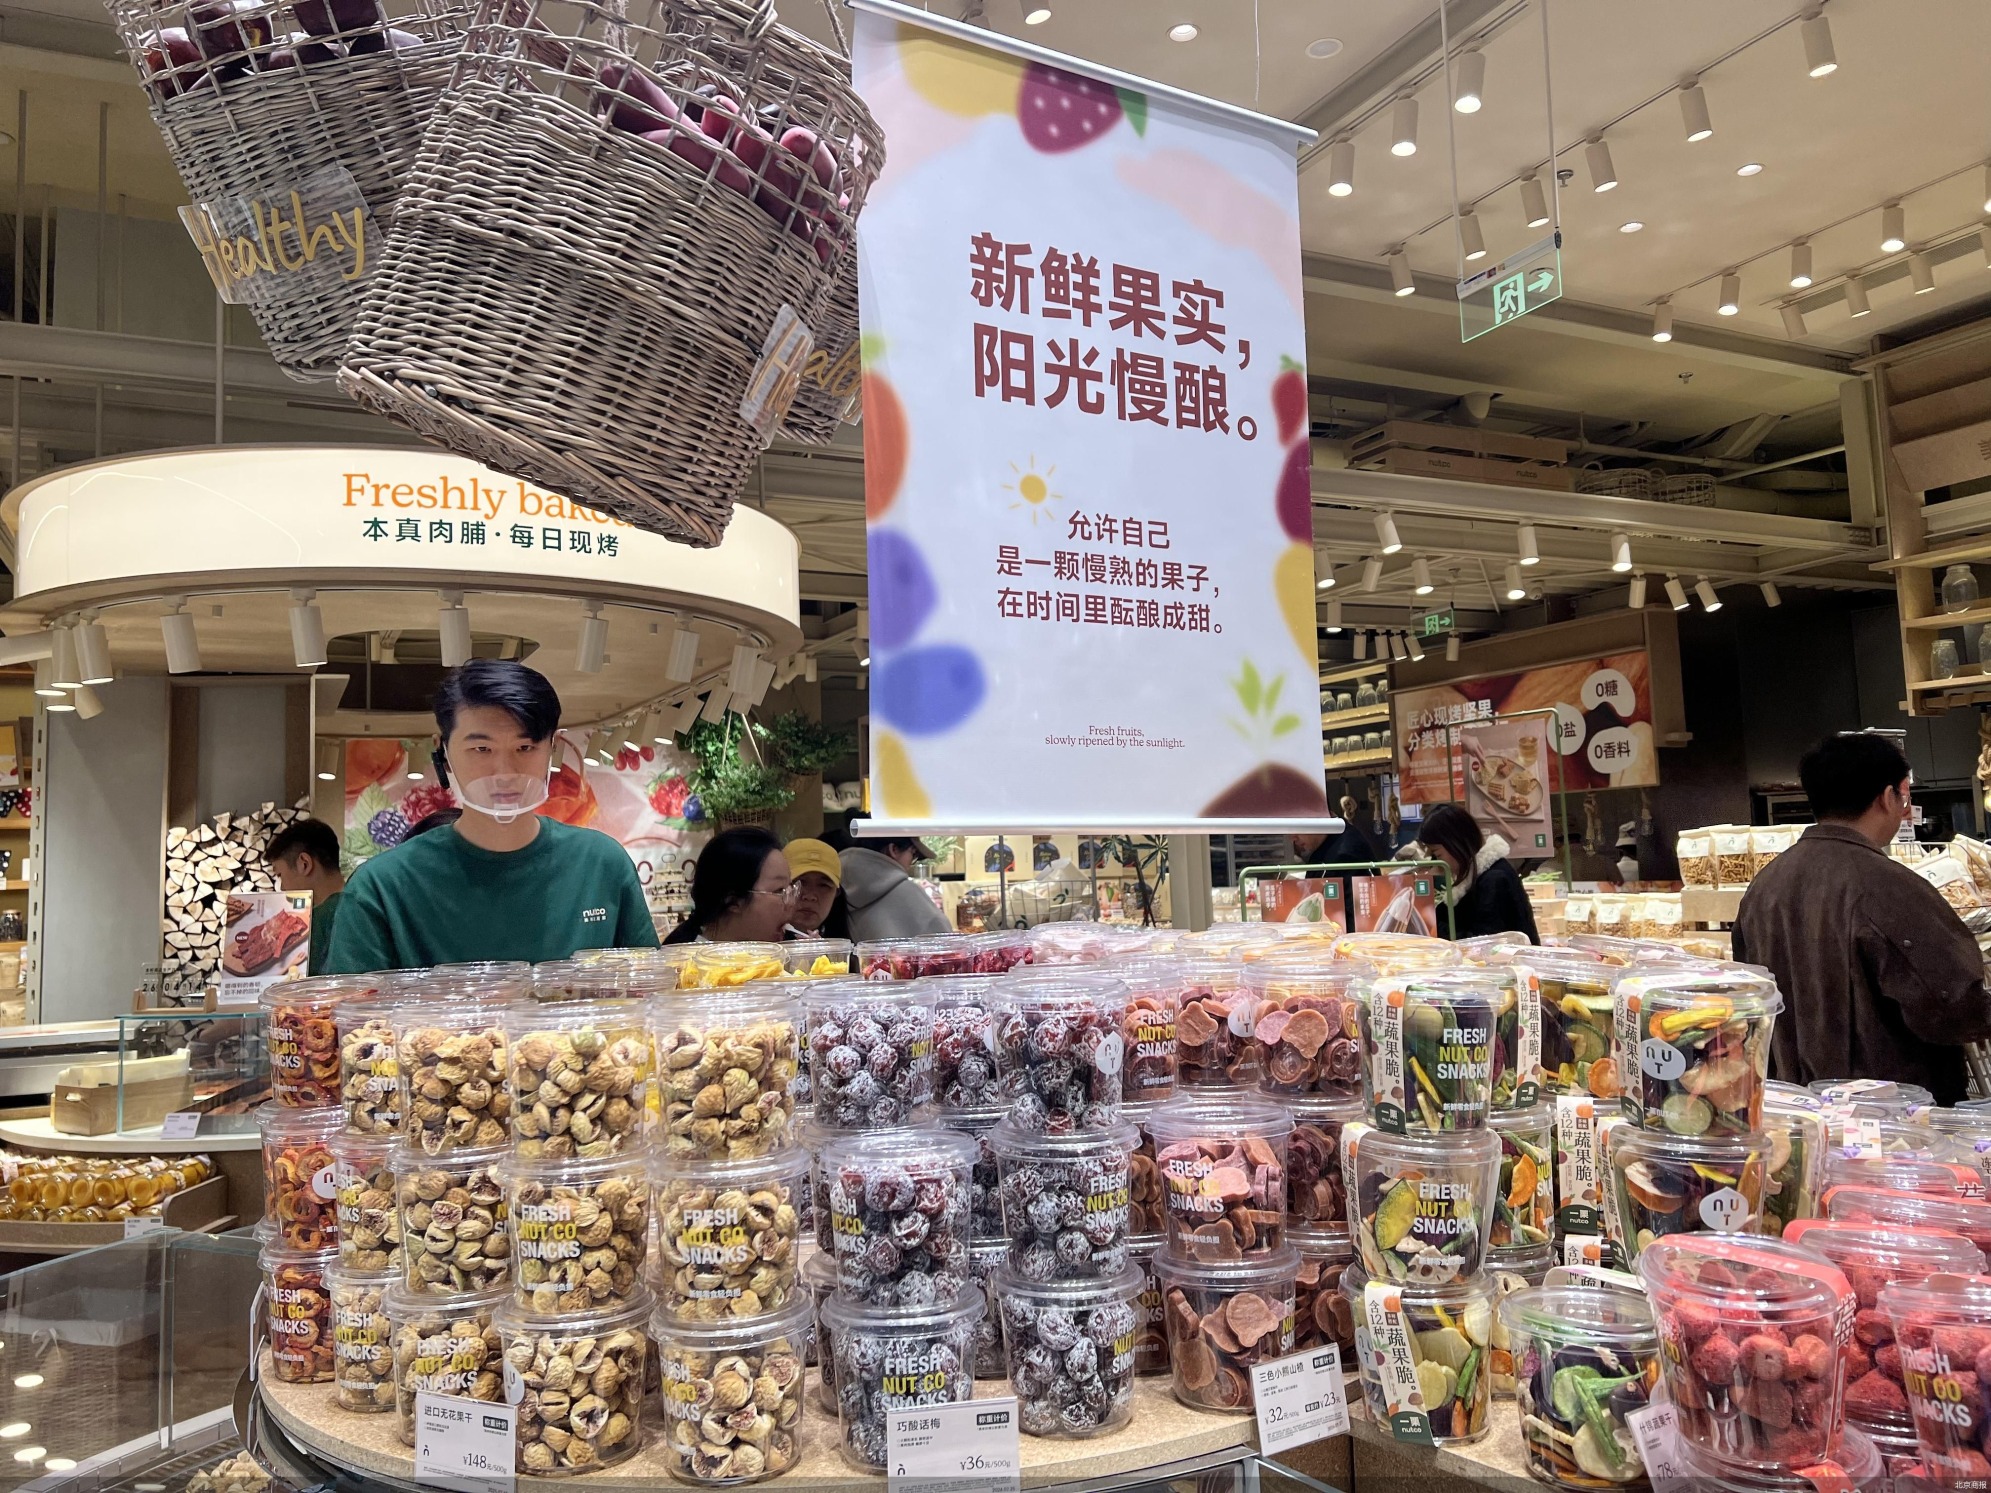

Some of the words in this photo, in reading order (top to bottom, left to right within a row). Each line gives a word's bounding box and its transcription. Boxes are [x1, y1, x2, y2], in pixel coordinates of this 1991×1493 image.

[970, 231, 1250, 370] 新鲜果实，
[973, 322, 1257, 440] 阳光慢酿。
[342, 472, 507, 520] Freshly
[362, 517, 619, 557] 本真肉脯·每日现烤
[1068, 510, 1170, 549] 允许自己
[996, 545, 1220, 599] 是一颗慢熟的果子，
[997, 587, 1223, 634] 在时间里酝酿成甜。
[1595, 679, 1619, 698] 0糖
[1089, 725, 1115, 736] Fresh
[1117, 726, 1145, 738] fruits,
[1045, 734, 1077, 747] slowly
[1078, 736, 1114, 747] ripened
[1116, 736, 1128, 747] by
[1129, 737, 1144, 747] the
[1146, 737, 1186, 749] sunlight.
[1594, 740, 1631, 760] 0香料
[1140, 1008, 1174, 1026] FRESH
[1373, 992, 1384, 1031] 含12种
[1138, 1026, 1163, 1042] NUT
[1443, 1027, 1487, 1045] FRESH
[1528, 1004, 1540, 1062] 蔬果脆。
[1136, 1040, 1178, 1058] SNACKS
[1384, 1020, 1400, 1085] 蔬果脆。
[1439, 1047, 1470, 1063] NUT
[1473, 1046, 1488, 1062] CO
[1625, 1023, 1640, 1085] 蔬果脆。
[1437, 1063, 1489, 1080] SNACKS
[1560, 1106, 1573, 1141] 含12种
[1169, 1158, 1215, 1179] FRESH
[1574, 1131, 1593, 1188] 蔬果脆。
[1090, 1172, 1127, 1193] FRESH
[1419, 1183, 1470, 1200] FRESH
[1086, 1193, 1113, 1212] NUT
[1170, 1194, 1225, 1213] SNACKS
[1415, 1200, 1449, 1218] NUT
[521, 1203, 571, 1222] FRESH
[683, 1208, 738, 1227] FRESH
[1085, 1205, 1129, 1229] SNACKS
[520, 1222, 548, 1241] NUT
[553, 1221, 577, 1240] CO
[1413, 1218, 1474, 1235] SNACKS
[681, 1228, 715, 1247] NUT
[719, 1226, 745, 1246] CO
[520, 1241, 581, 1259] SNACKS
[680, 1245, 749, 1264] SNACKS
[270, 1288, 301, 1303] FRESH
[287, 1304, 306, 1319] CO
[335, 1310, 373, 1327] FRESH
[1369, 1299, 1385, 1340] 含12种
[271, 1319, 310, 1335] SNACKS
[335, 1327, 355, 1343] NUT
[357, 1328, 378, 1345] CO
[335, 1345, 382, 1361] SNACKS
[417, 1336, 470, 1355] FRESH
[414, 1357, 441, 1374] NUT
[451, 1354, 475, 1372] CO
[884, 1355, 941, 1375] FRESH
[1386, 1327, 1417, 1391] 蔬果脆。
[414, 1371, 478, 1391] SNACKS
[882, 1375, 917, 1395] NUT
[923, 1371, 946, 1392] CO
[1932, 1375, 1963, 1403] CO
[881, 1391, 948, 1412] SNACKS
[424, 1405, 473, 1424] 进口无花果干
[896, 1417, 941, 1433] 巧酸话梅
[1401, 1424, 1423, 1434] nutco
